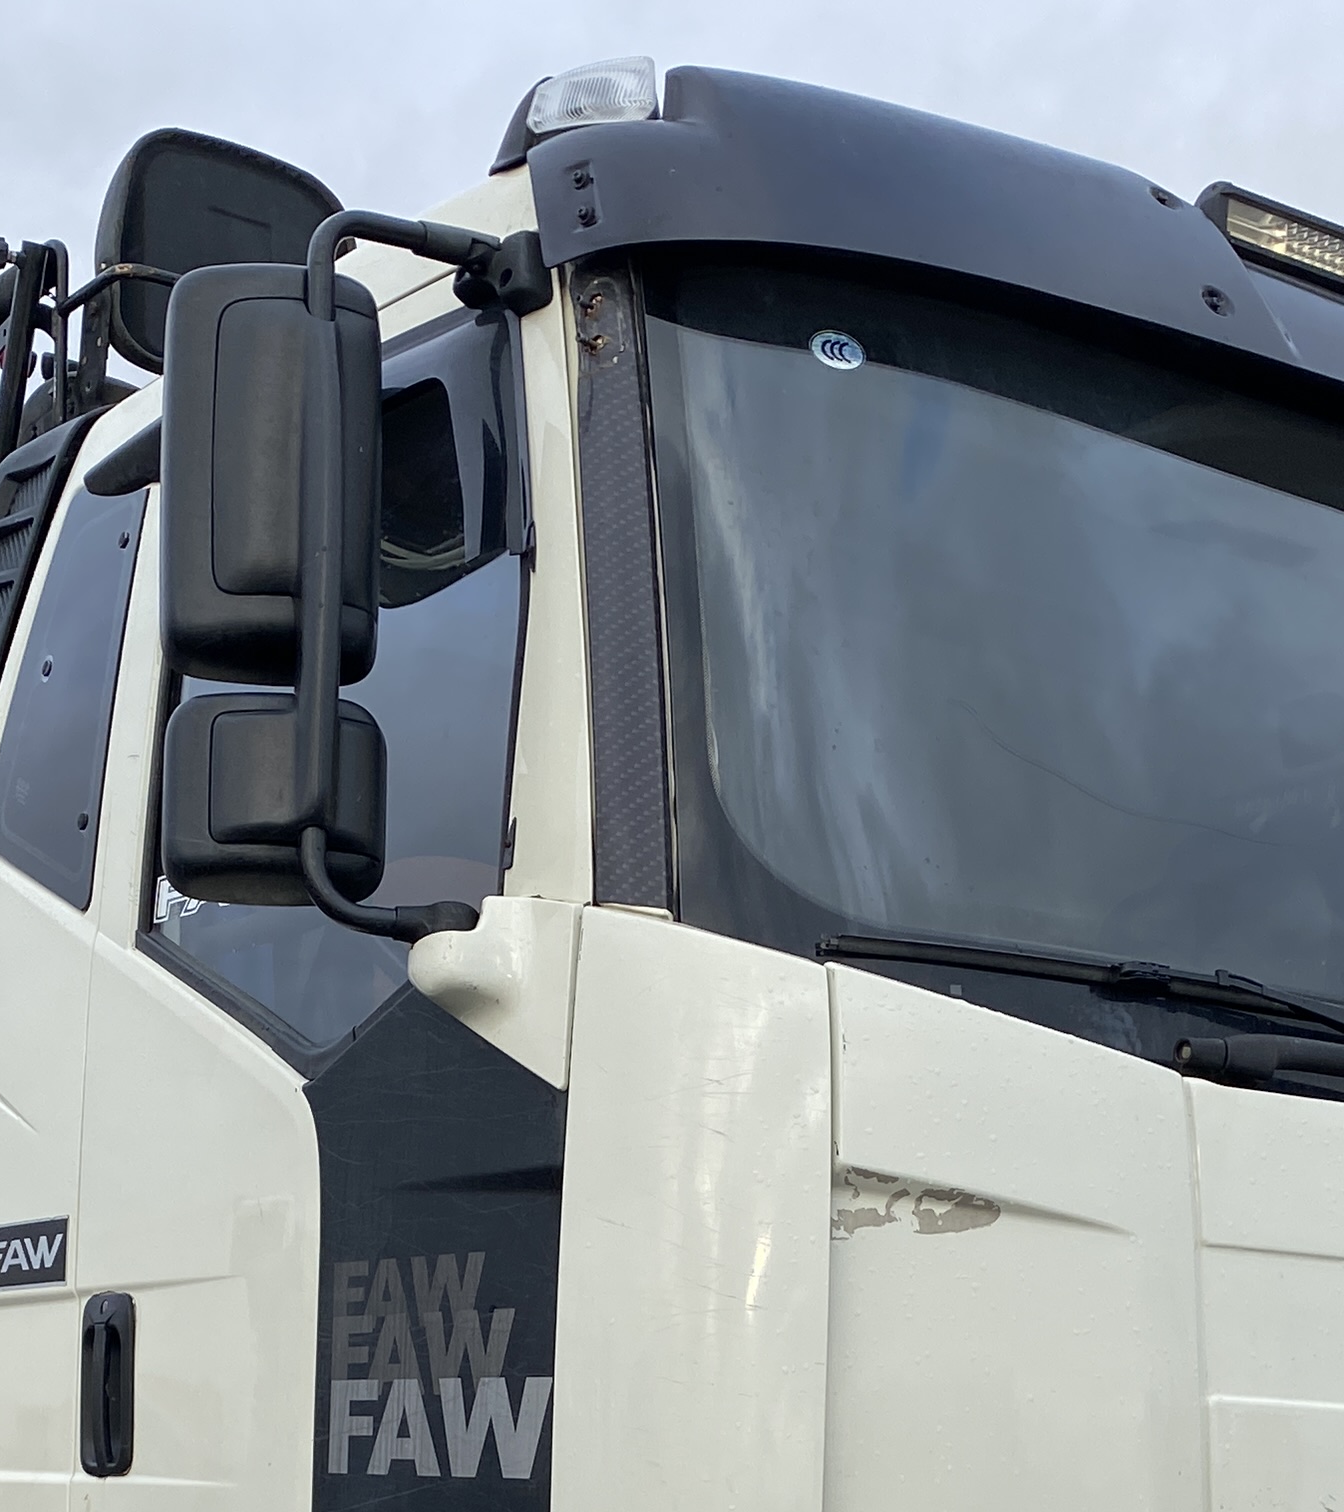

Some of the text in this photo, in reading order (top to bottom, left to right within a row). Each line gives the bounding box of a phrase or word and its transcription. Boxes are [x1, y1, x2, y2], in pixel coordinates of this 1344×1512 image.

[821, 339, 852, 364] CCC
[333, 1252, 486, 1328] FAW
[331, 1308, 515, 1395] FAW
[328, 1377, 553, 1479] FAW
